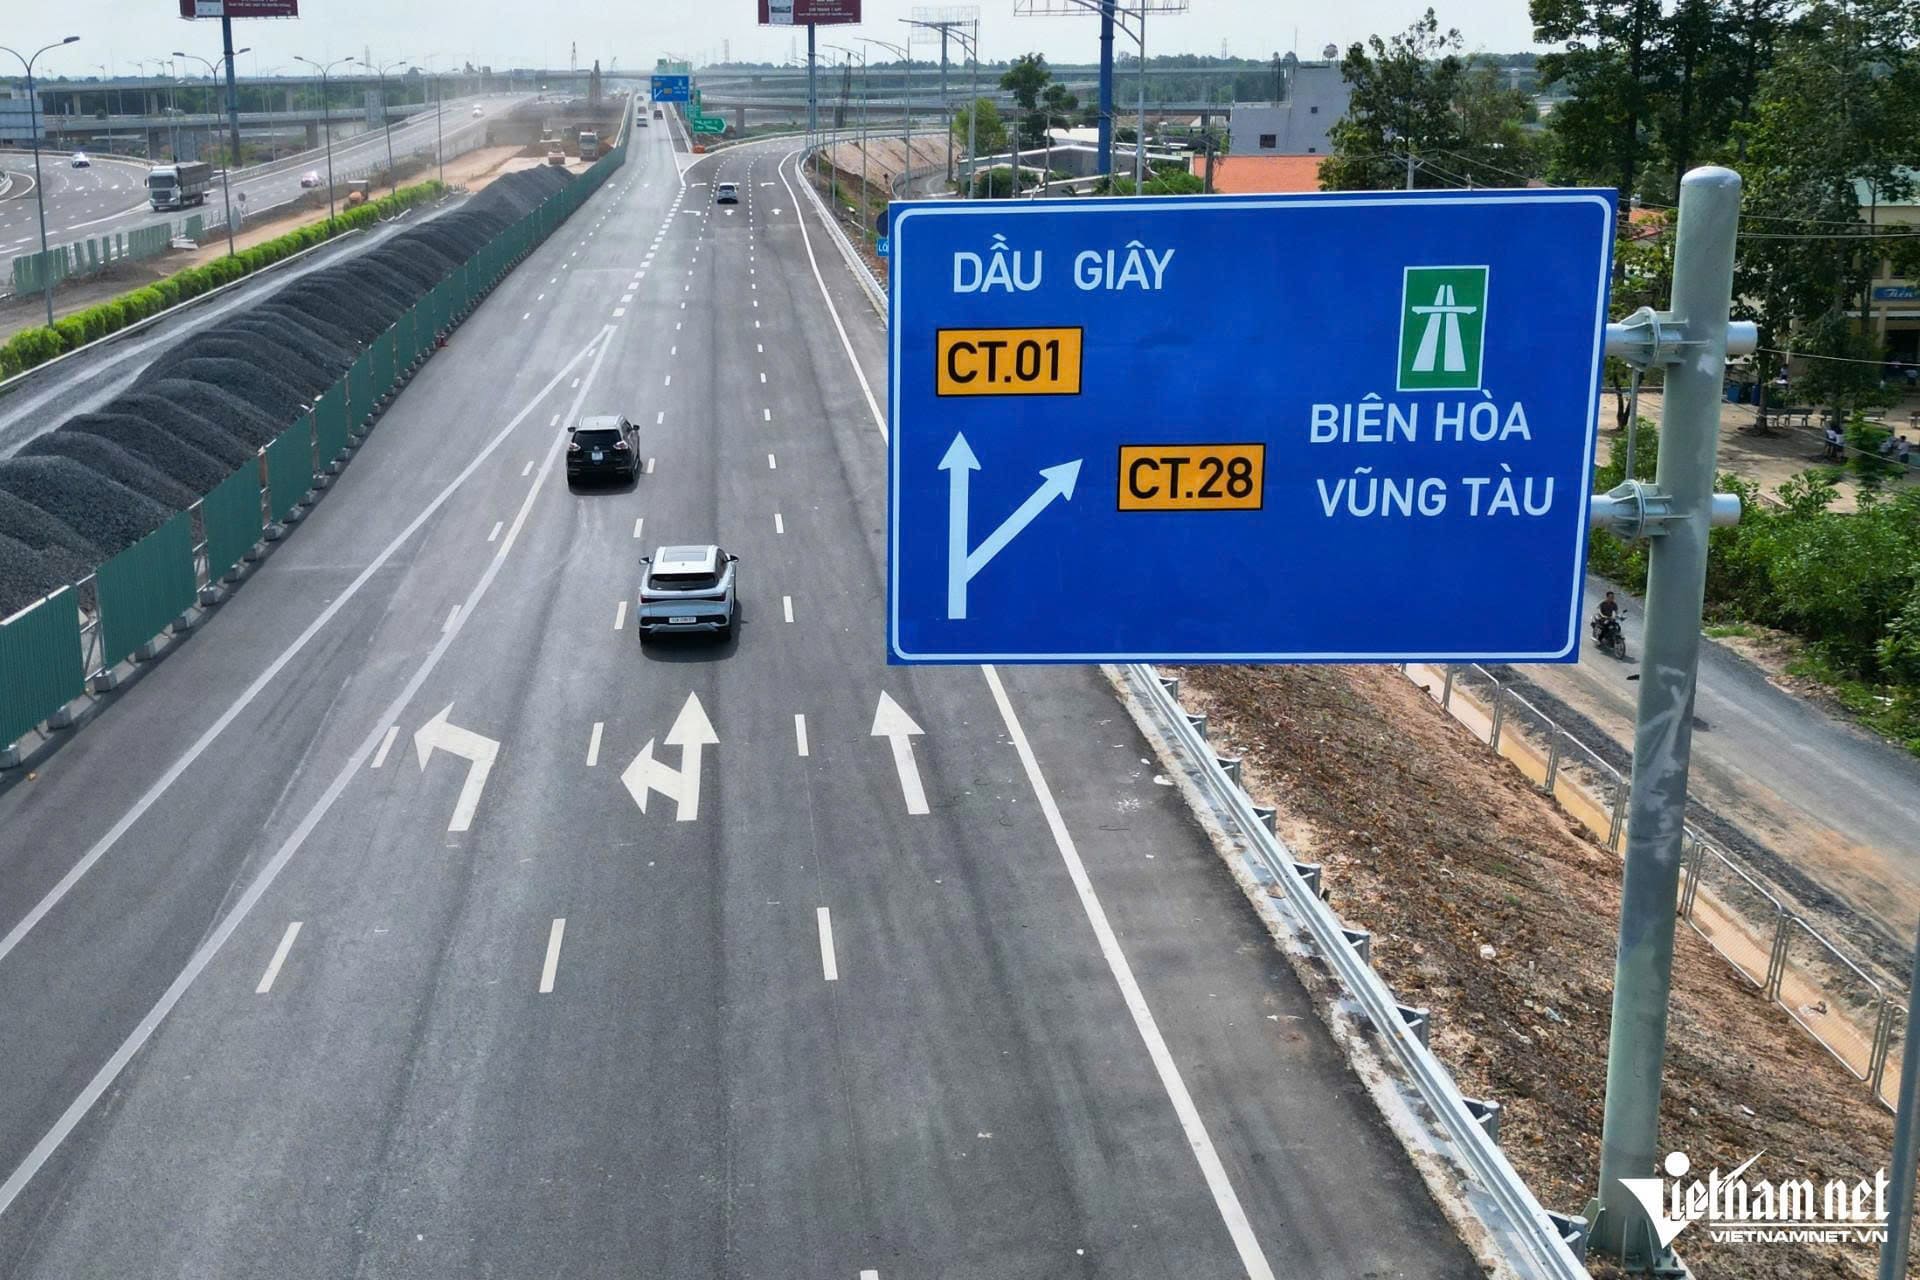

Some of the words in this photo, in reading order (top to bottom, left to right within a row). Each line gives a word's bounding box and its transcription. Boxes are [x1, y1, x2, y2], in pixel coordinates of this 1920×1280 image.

[954, 234, 1042, 293] DẦU
[1074, 240, 1175, 291] GIÂY
[951, 340, 1057, 383] CT.01
[1310, 392, 1418, 443] BIÊN
[1434, 388, 1532, 442] HÒA
[1129, 457, 1254, 500] CT.28
[1316, 467, 1447, 517] VŨNG
[1463, 463, 1555, 516] TÀU
